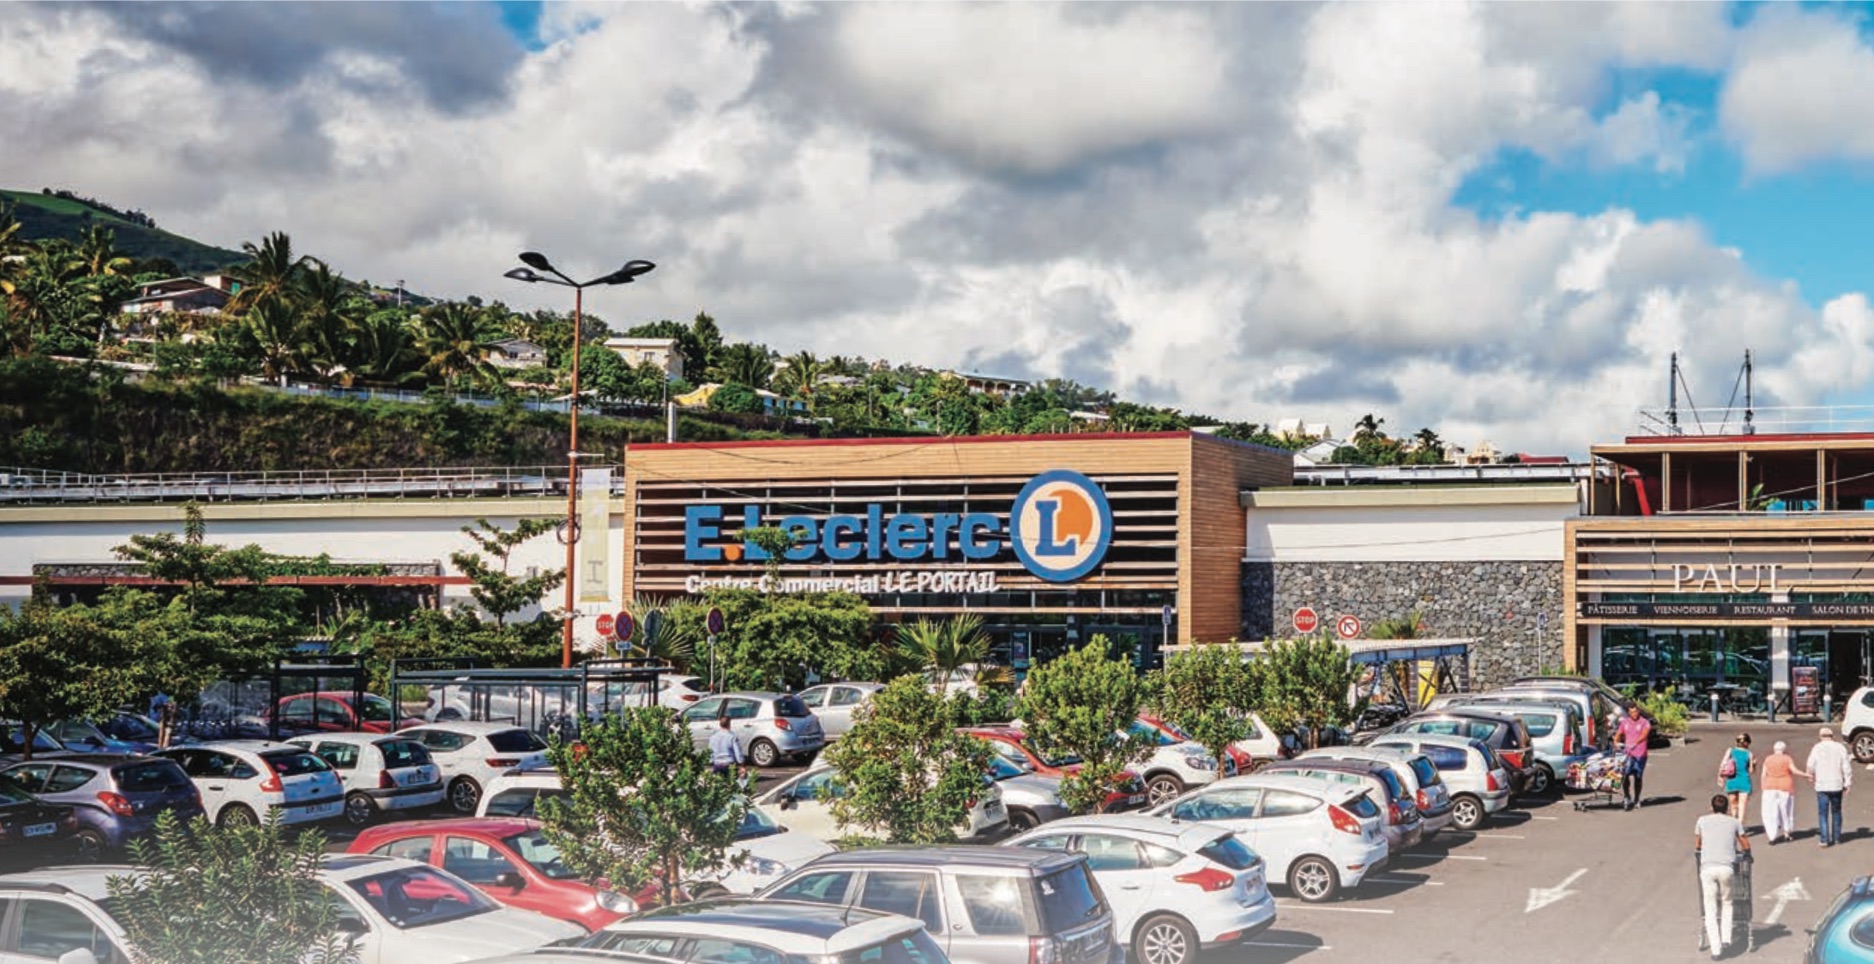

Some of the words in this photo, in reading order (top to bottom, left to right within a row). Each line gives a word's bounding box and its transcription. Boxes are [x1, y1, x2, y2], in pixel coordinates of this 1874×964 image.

[685, 503, 1001, 562] E.Leclerc
[758, 574, 880, 594] Commercial
[884, 571, 913, 593] LE
[917, 571, 1001, 593] PORTAIL
[1671, 563, 1794, 594] PAUL
[1295, 615, 1315, 624] STOP
[1587, 603, 1638, 615] PÂTISSERIE
[1653, 605, 1718, 615] VIENNOISERIE
[1734, 605, 1796, 615] RESTAURANT
[1812, 605, 1844, 615] SALON
[1846, 605, 1858, 615] DE
[1860, 605, 1874, 615] TH
